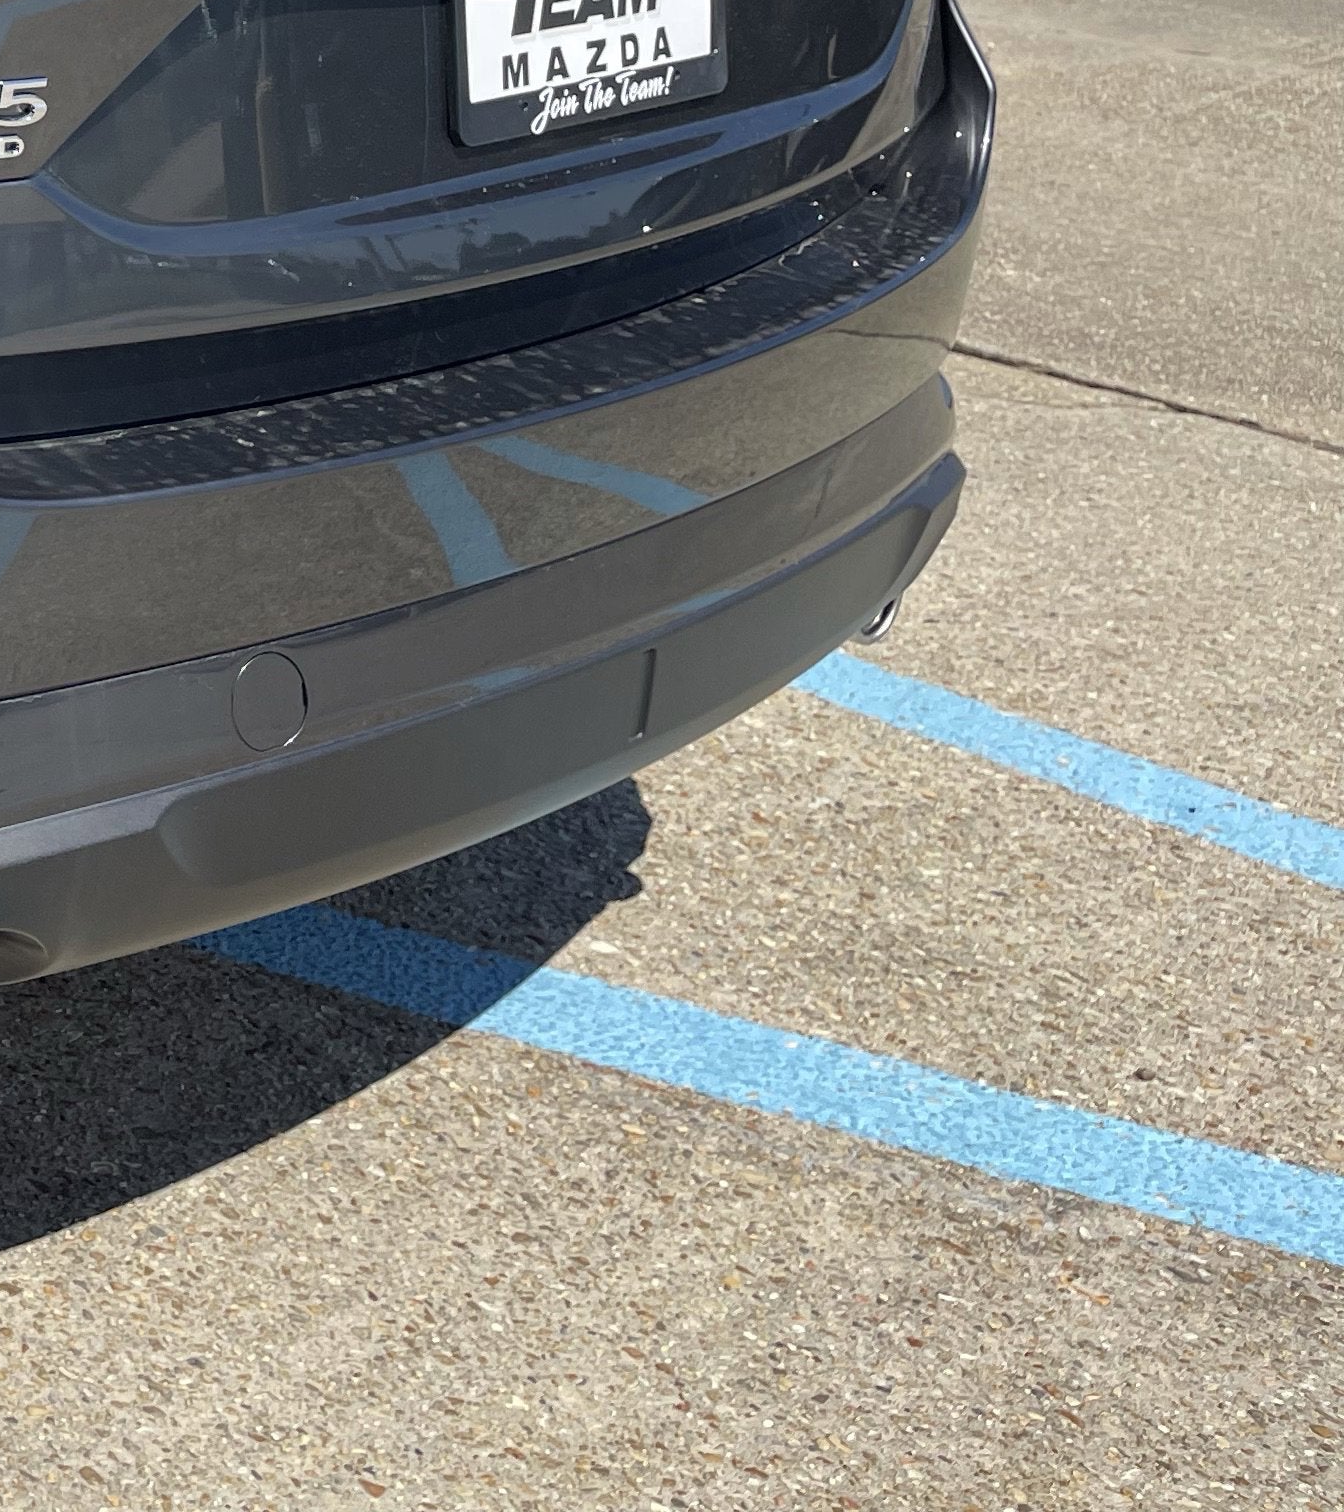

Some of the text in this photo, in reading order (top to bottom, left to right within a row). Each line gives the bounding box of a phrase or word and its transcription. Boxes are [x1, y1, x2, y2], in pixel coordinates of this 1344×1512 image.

[502, 26, 672, 90] MAZDA
[530, 65, 675, 135] Join The Team!
